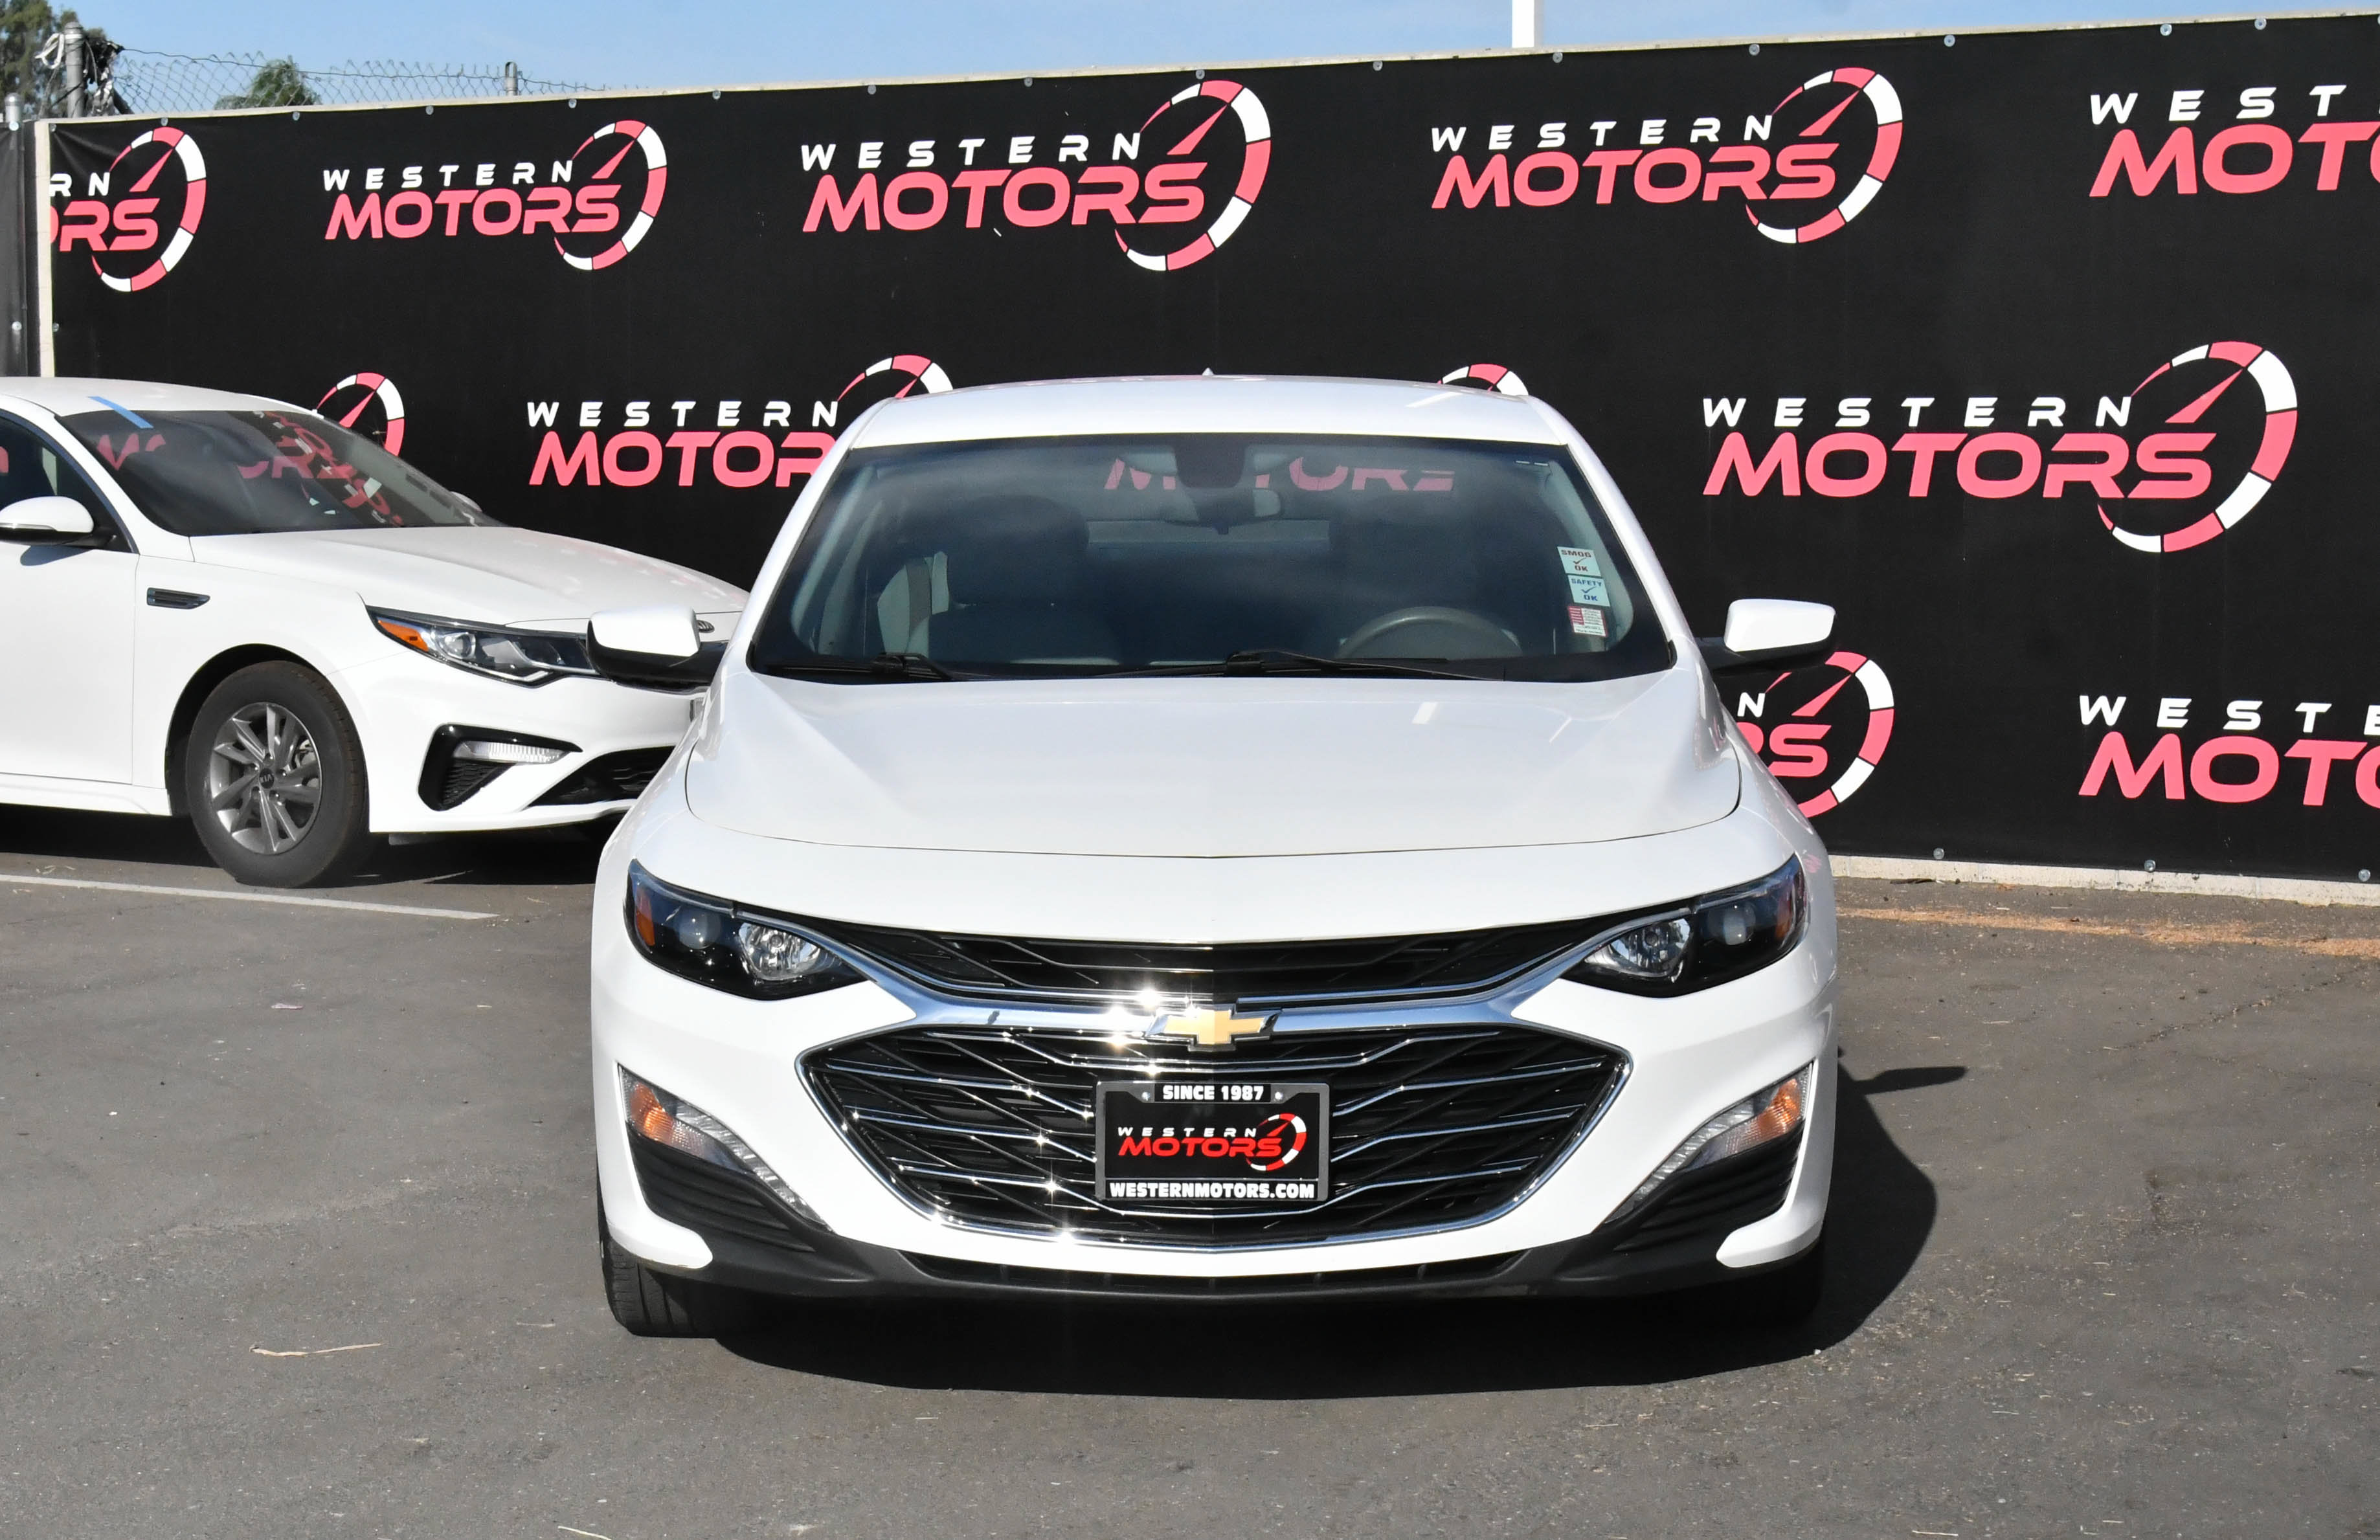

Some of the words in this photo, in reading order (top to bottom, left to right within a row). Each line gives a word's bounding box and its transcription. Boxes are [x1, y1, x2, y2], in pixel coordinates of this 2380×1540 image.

[2090, 85, 2380, 124] WEST
[802, 133, 1140, 171] WESTERN
[1432, 115, 1772, 151] WESTERN
[324, 161, 572, 192] WESTERN
[1432, 143, 1839, 208] MOTORS
[2090, 122, 2380, 197] MOT
[325, 184, 621, 240] MOTORS
[803, 162, 1207, 232] MOTORS
[50, 197, 161, 252] RS
[528, 401, 838, 427] WESTERN
[1703, 396, 2131, 427] WESTERN
[1703, 432, 2216, 498] MOTORS
[2078, 731, 2380, 809] MOT
[1163, 1084, 1215, 1100] SINCE
[1221, 1085, 1264, 1101] 1987
[1117, 1127, 1257, 1137] WESTERN
[1118, 1137, 1282, 1157] MOTORS
[1110, 1182, 1314, 1199] WESTERNMOTORS.COM
